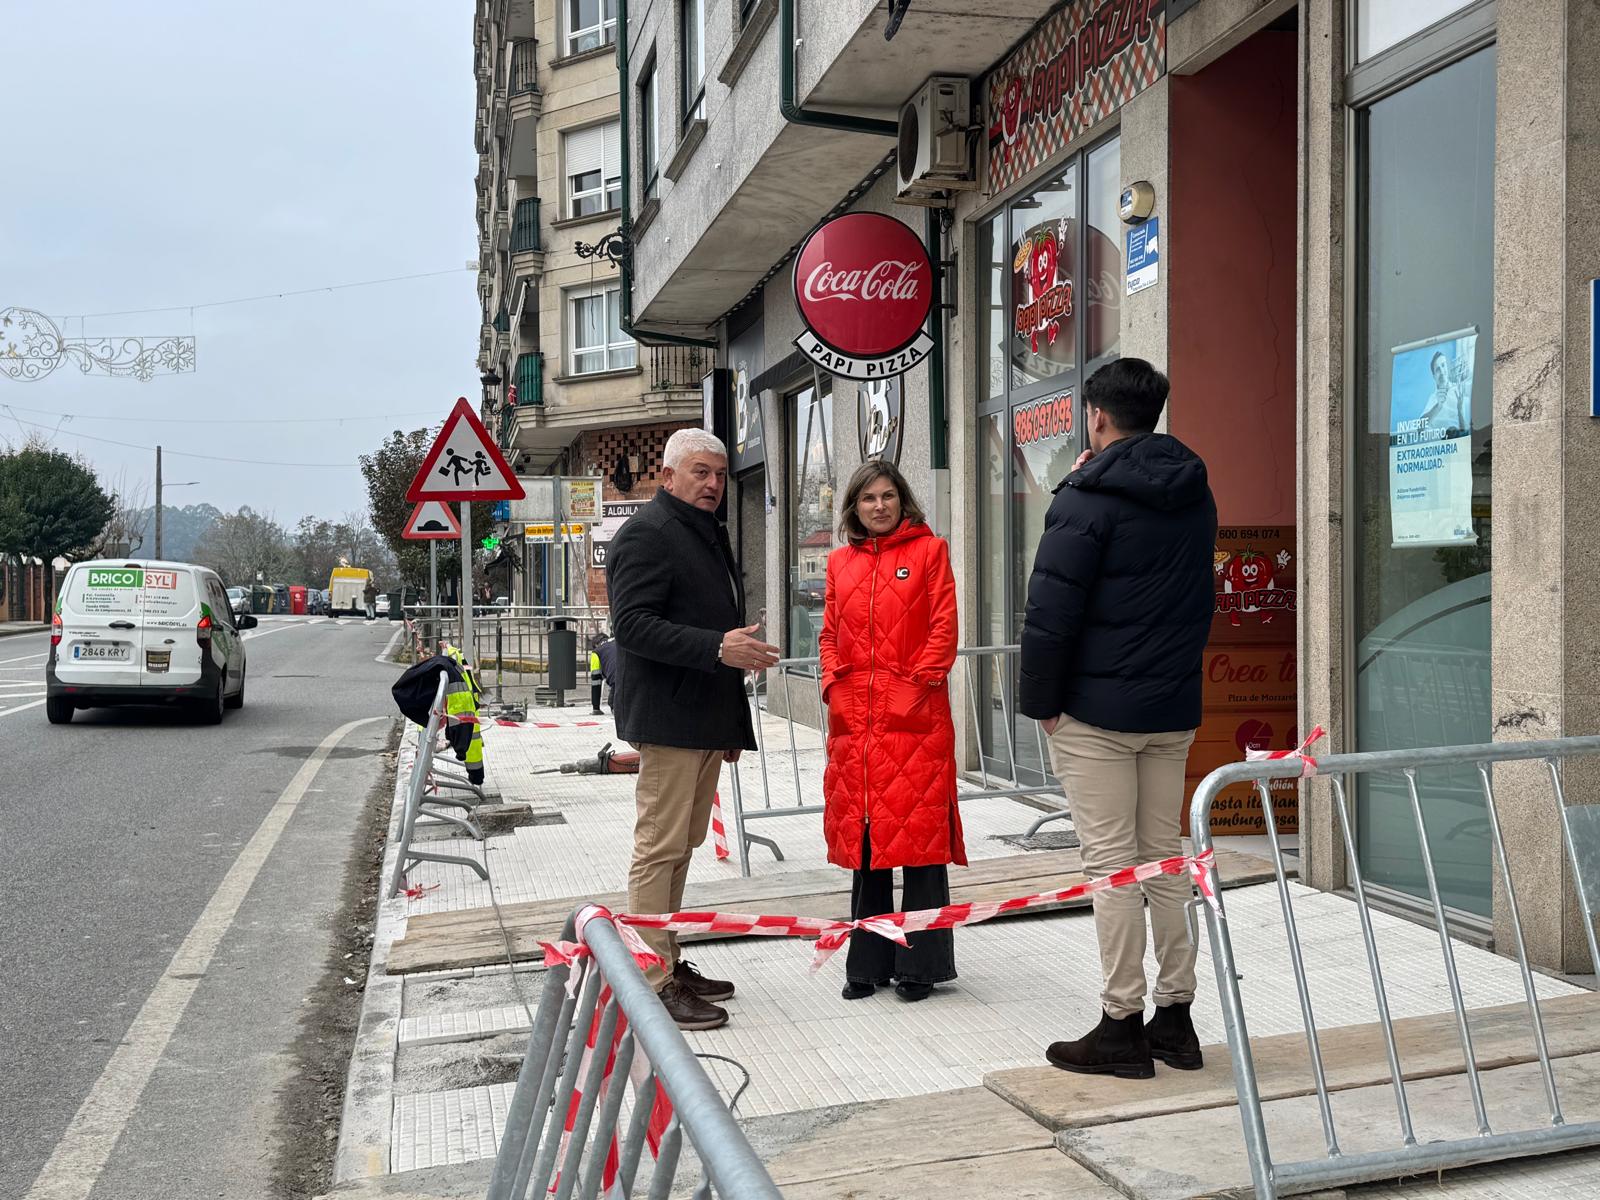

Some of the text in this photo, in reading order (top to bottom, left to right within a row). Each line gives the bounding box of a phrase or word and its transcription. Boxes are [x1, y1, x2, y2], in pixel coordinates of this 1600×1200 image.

[1030, 0, 1151, 124] PAPI PIZZA
[804, 260, 923, 302] Coca-Cola
[809, 343, 923, 376] PAPI PIZZA
[1397, 417, 1429, 433] INVIERTE
[1397, 427, 1449, 446] EN TU FUTURO,
[1397, 443, 1458, 462] EXTRAORDINARIA
[1397, 459, 1445, 475] NORMALIDAD.
[607, 505, 639, 516] ALQUILA
[1219, 529, 1280, 539] 600 694 074
[91, 573, 170, 586] BRICO SYL
[1215, 589, 1297, 612] API PIZZA
[82, 648, 126, 657] 2846 KRY
[1209, 653, 1268, 683] Crea
[1211, 796, 1242, 810] asta
